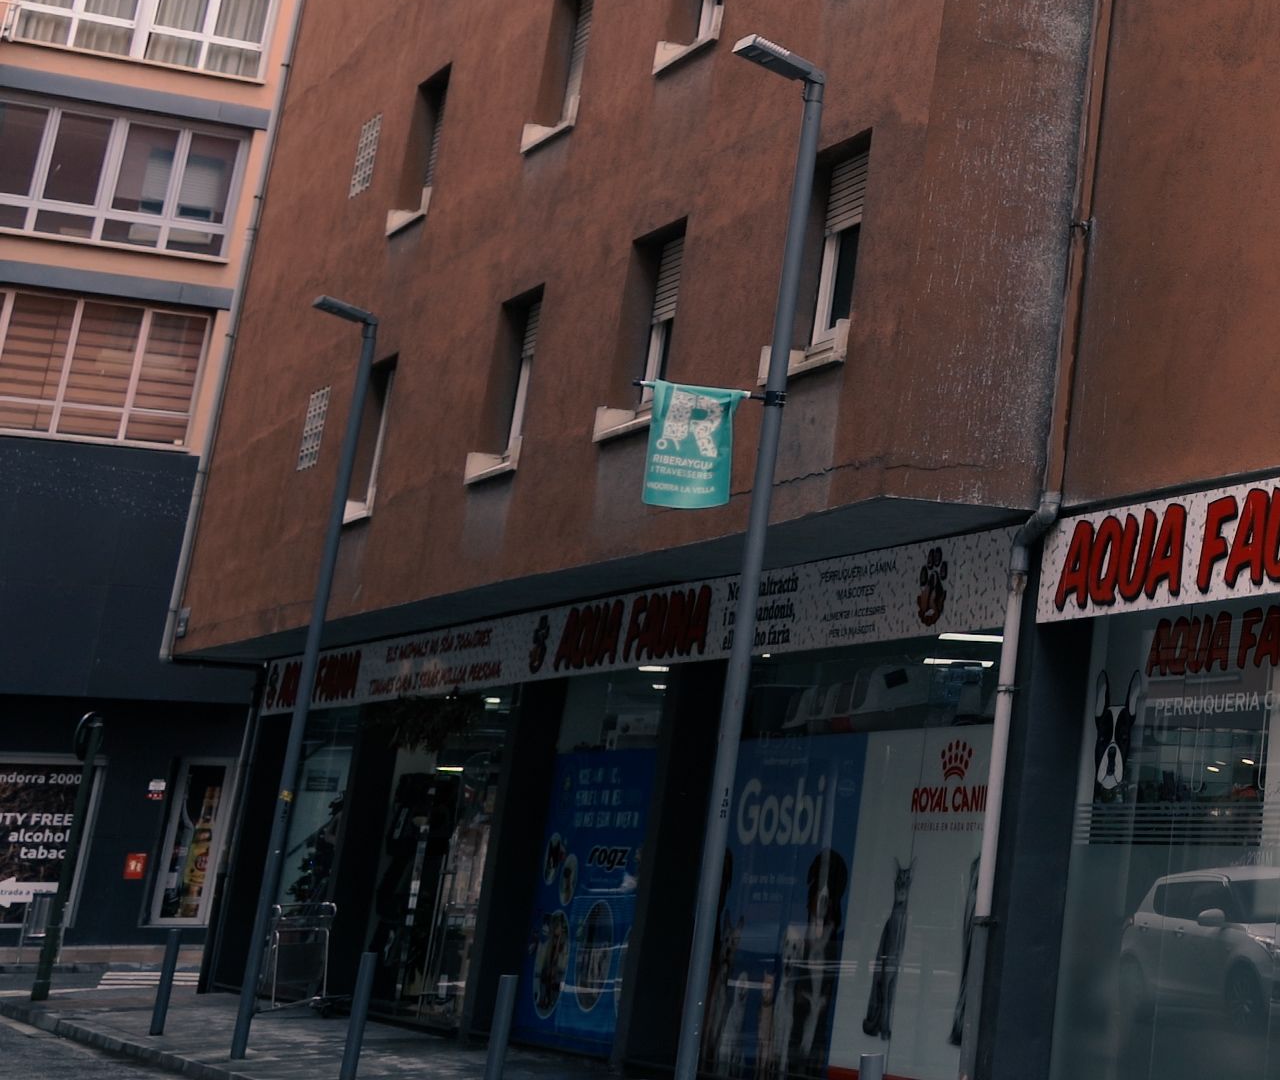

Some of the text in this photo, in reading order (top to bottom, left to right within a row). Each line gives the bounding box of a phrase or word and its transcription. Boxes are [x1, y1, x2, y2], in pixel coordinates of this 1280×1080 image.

[1055, 502, 1188, 613] AQUA
[758, 573, 799, 597] altractis
[554, 584, 713, 673] AQUA FAUNA
[1146, 610, 1233, 678] AQUA
[1154, 693, 1260, 717] PERRUQUERIA
[0, 772, 82, 785] ndorra 2000
[737, 774, 823, 845] Gosbi
[911, 785, 949, 813] ROYAL
[0, 812, 75, 826] TY FREE
[8, 829, 71, 843] alcohol
[20, 846, 67, 859] tabac
[587, 845, 630, 872] rogz
